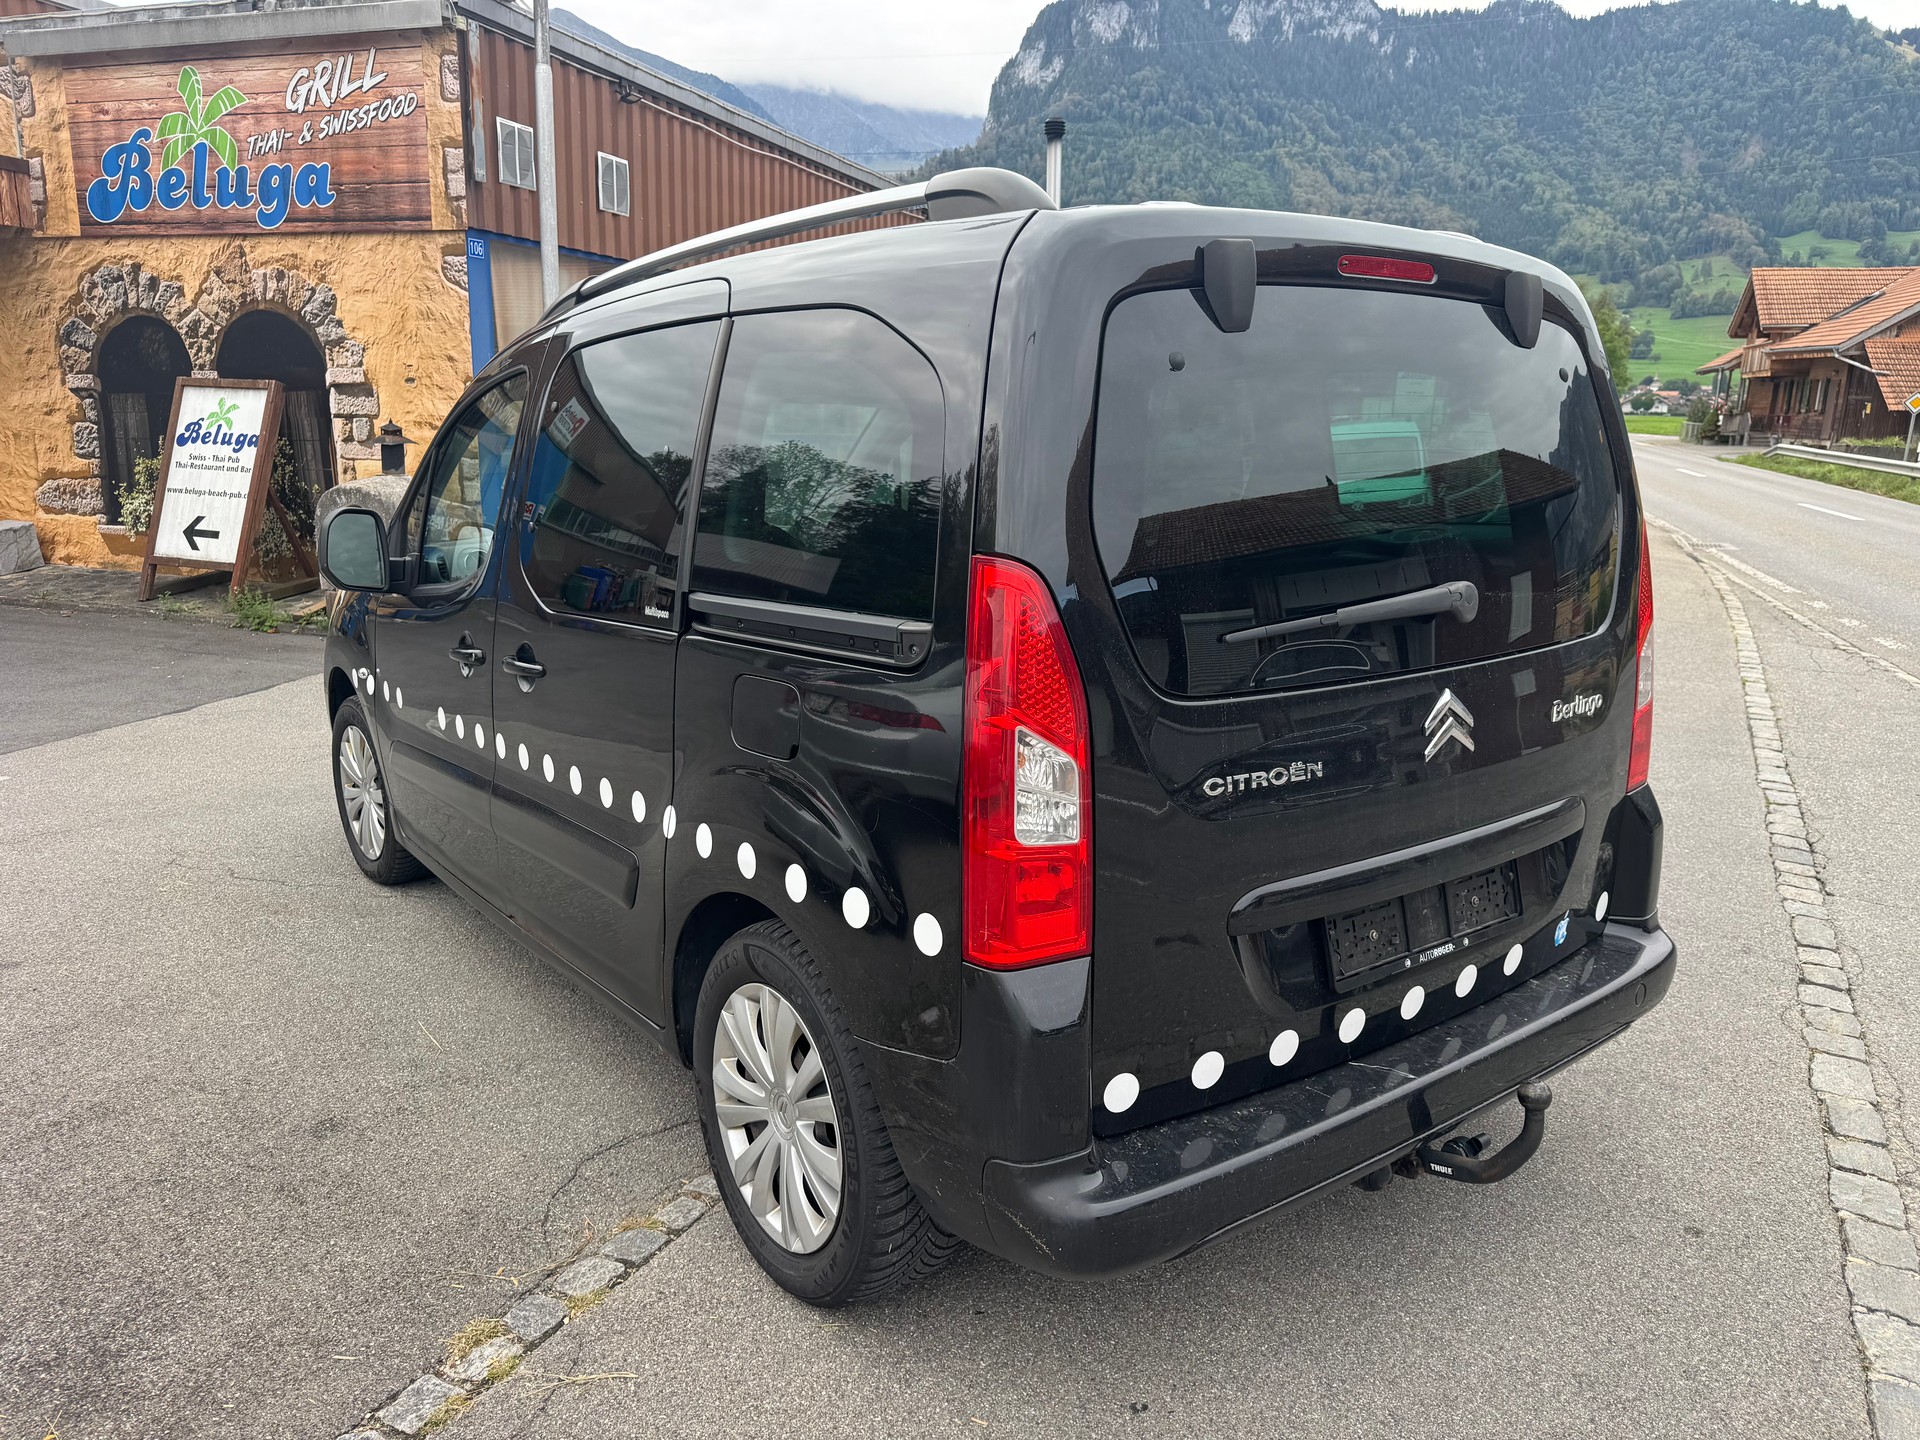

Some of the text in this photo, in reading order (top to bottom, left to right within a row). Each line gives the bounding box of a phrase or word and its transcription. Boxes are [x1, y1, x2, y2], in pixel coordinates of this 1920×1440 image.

[285, 47, 389, 114] GRILL
[247, 92, 418, 160] THAI- & SWISSFOOD
[86, 126, 336, 230] Beluga
[470, 241, 483, 256] 106
[176, 417, 260, 453] Beluga
[175, 461, 252, 474] Thai-Restaurant und Bar
[188, 453, 207, 462] Swiss
[212, 454, 226, 463] Thai
[227, 456, 240, 464] Pub
[1551, 694, 1603, 723] Berlingo
[1202, 761, 1324, 798] CITROËN
[1430, 1163, 1453, 1175] THULE
